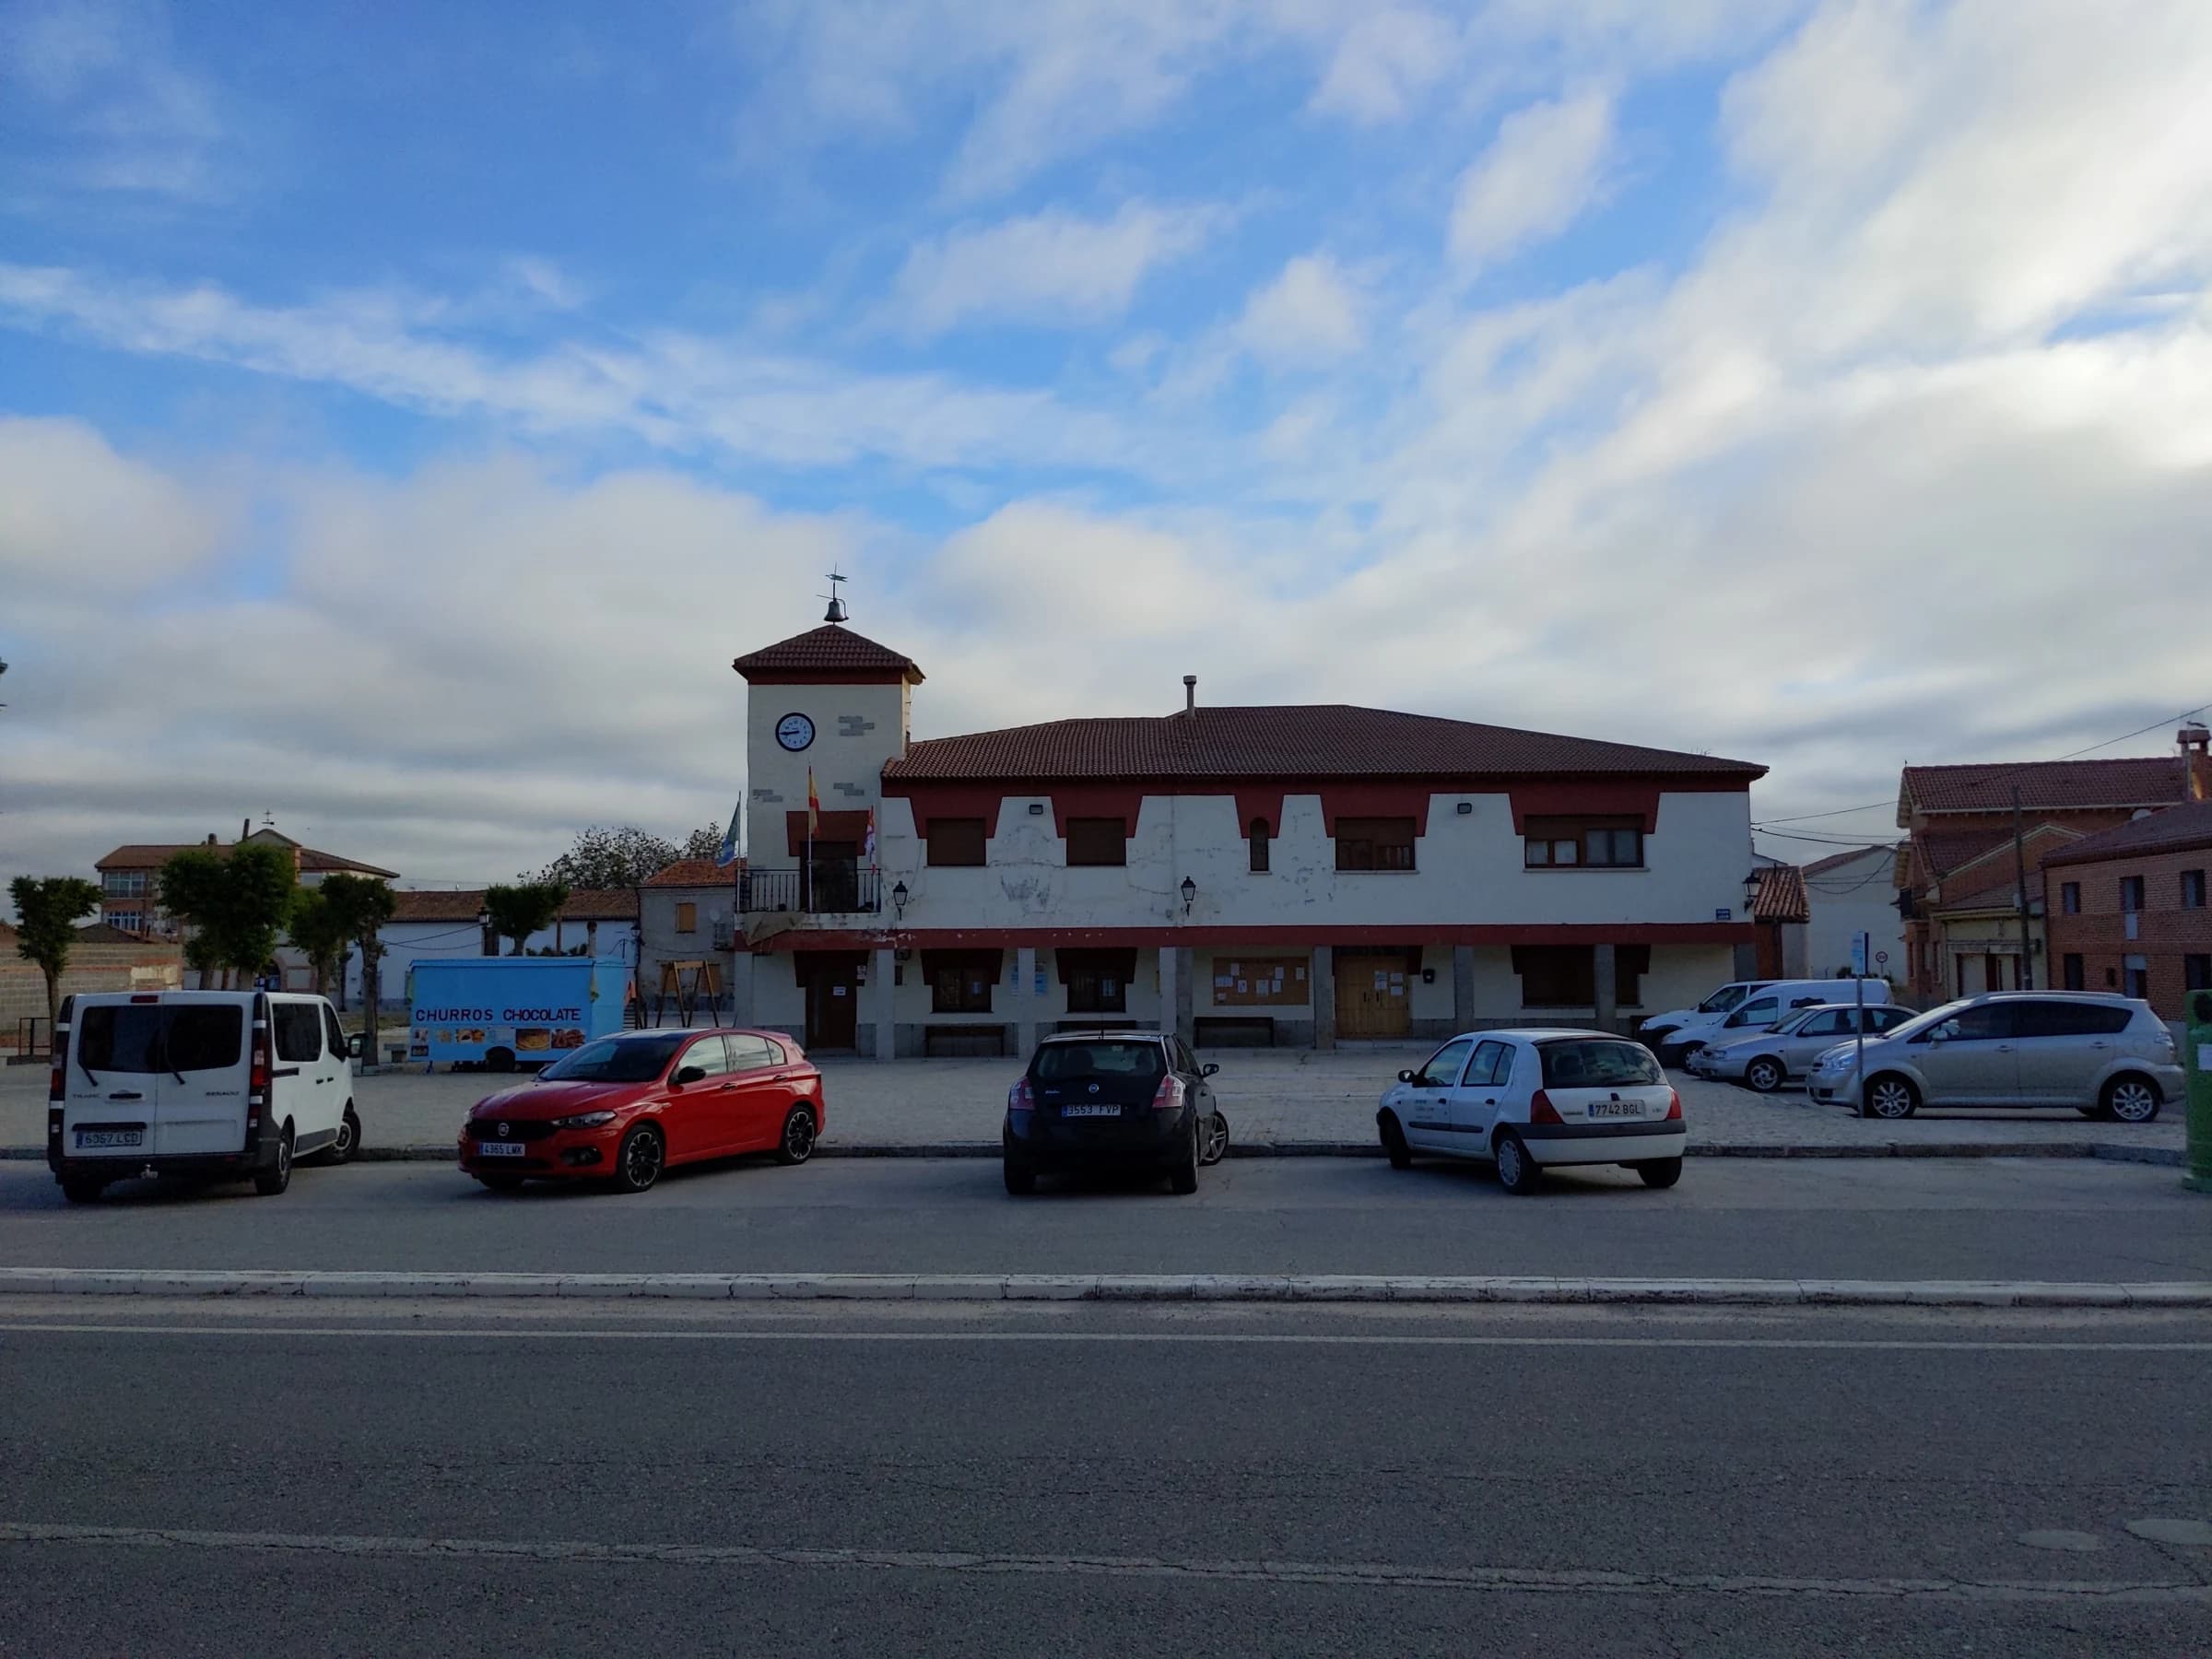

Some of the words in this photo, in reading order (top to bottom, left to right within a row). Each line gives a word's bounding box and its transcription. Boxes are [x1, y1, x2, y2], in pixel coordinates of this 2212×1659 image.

[416, 1008, 493, 1021] CHURROS
[503, 1008, 582, 1021] CHOCOLATE
[1068, 1104, 1093, 1115] 3553
[1099, 1104, 1119, 1114] FVP
[1595, 1104, 1620, 1115] 7742
[1622, 1103, 1641, 1115] BGL
[117, 1133, 138, 1143] LCD
